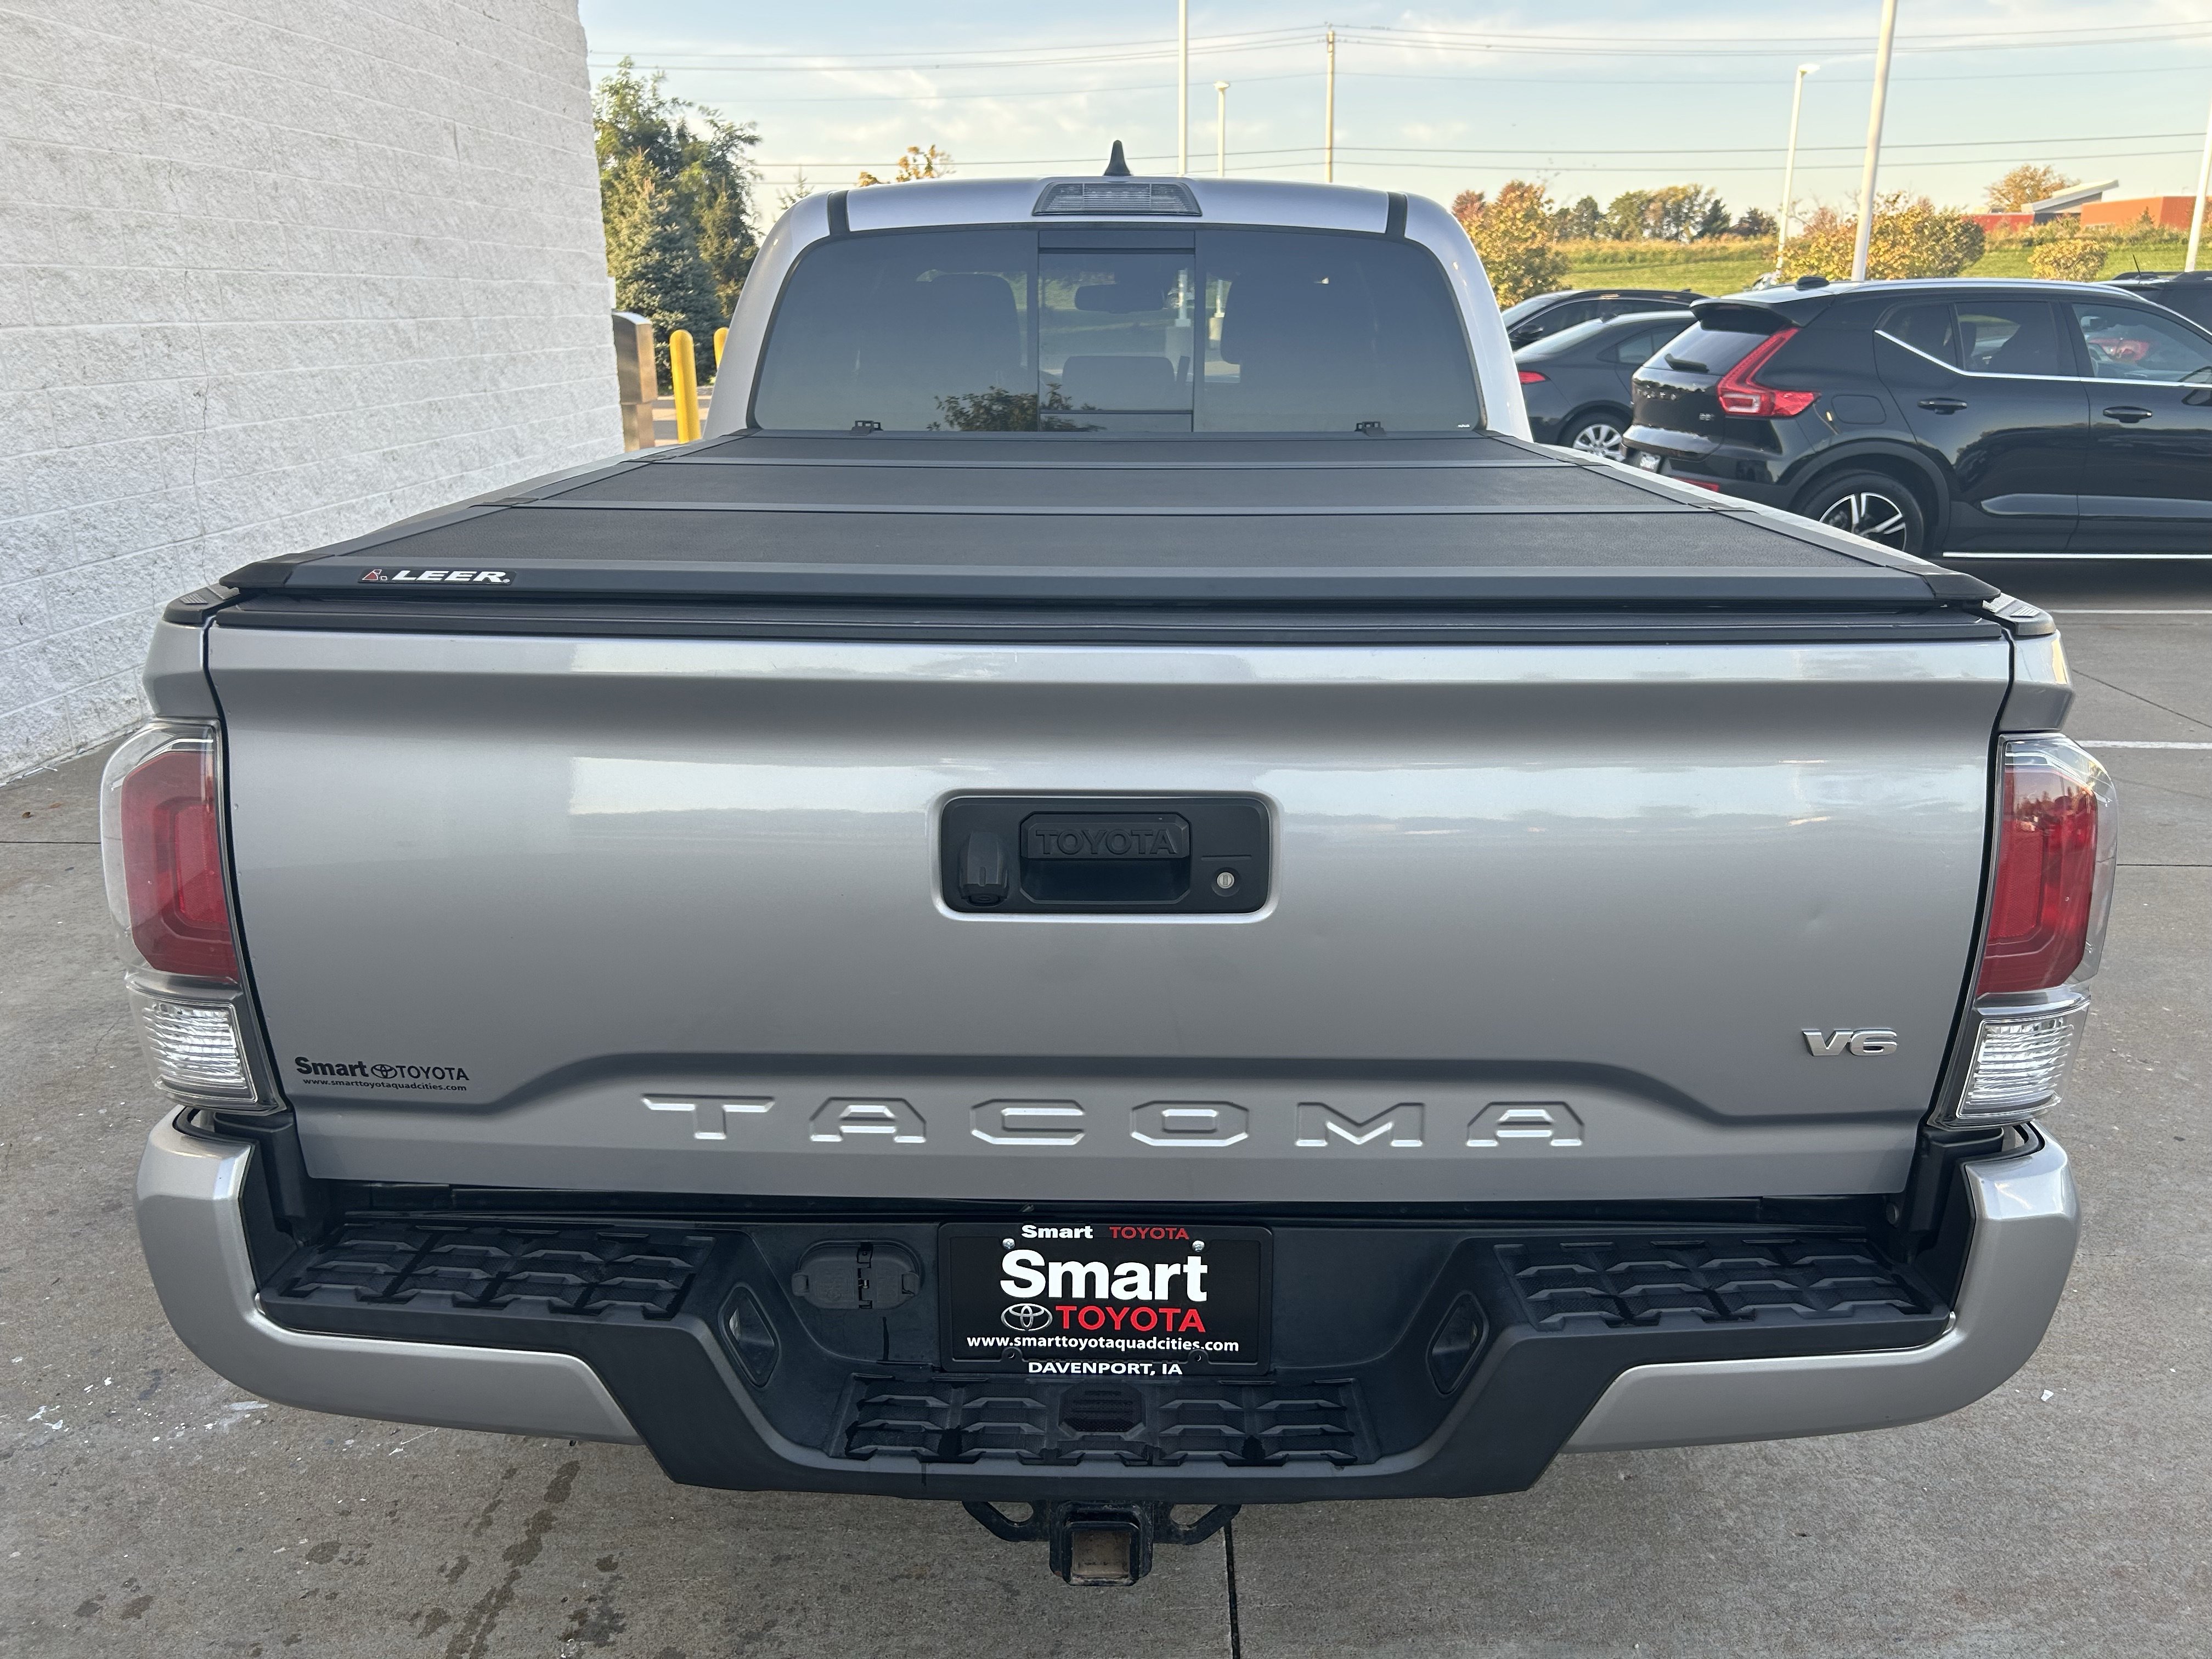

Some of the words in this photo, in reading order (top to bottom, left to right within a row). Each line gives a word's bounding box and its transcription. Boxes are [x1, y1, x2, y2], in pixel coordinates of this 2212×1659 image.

[392, 570, 506, 583] LEER
[1035, 829, 1178, 856] TOYOTA
[1802, 1029, 1898, 1057] V6
[295, 1057, 369, 1077] Smart
[396, 1065, 470, 1081] TOYOTA
[303, 1079, 467, 1091] www.smarttoyotaquadcities.com
[641, 1093, 1584, 1148] TACOMA
[1021, 1224, 1093, 1239] Smart
[1109, 1226, 1189, 1240] TOYOTA
[1000, 1249, 1208, 1302] Smart
[1056, 1305, 1206, 1333] TOYOTA
[967, 1335, 1239, 1352] www.smarttoyotaquadcities.com
[1028, 1362, 1155, 1376] DAVENPORT,
[1162, 1364, 1183, 1375] IA
